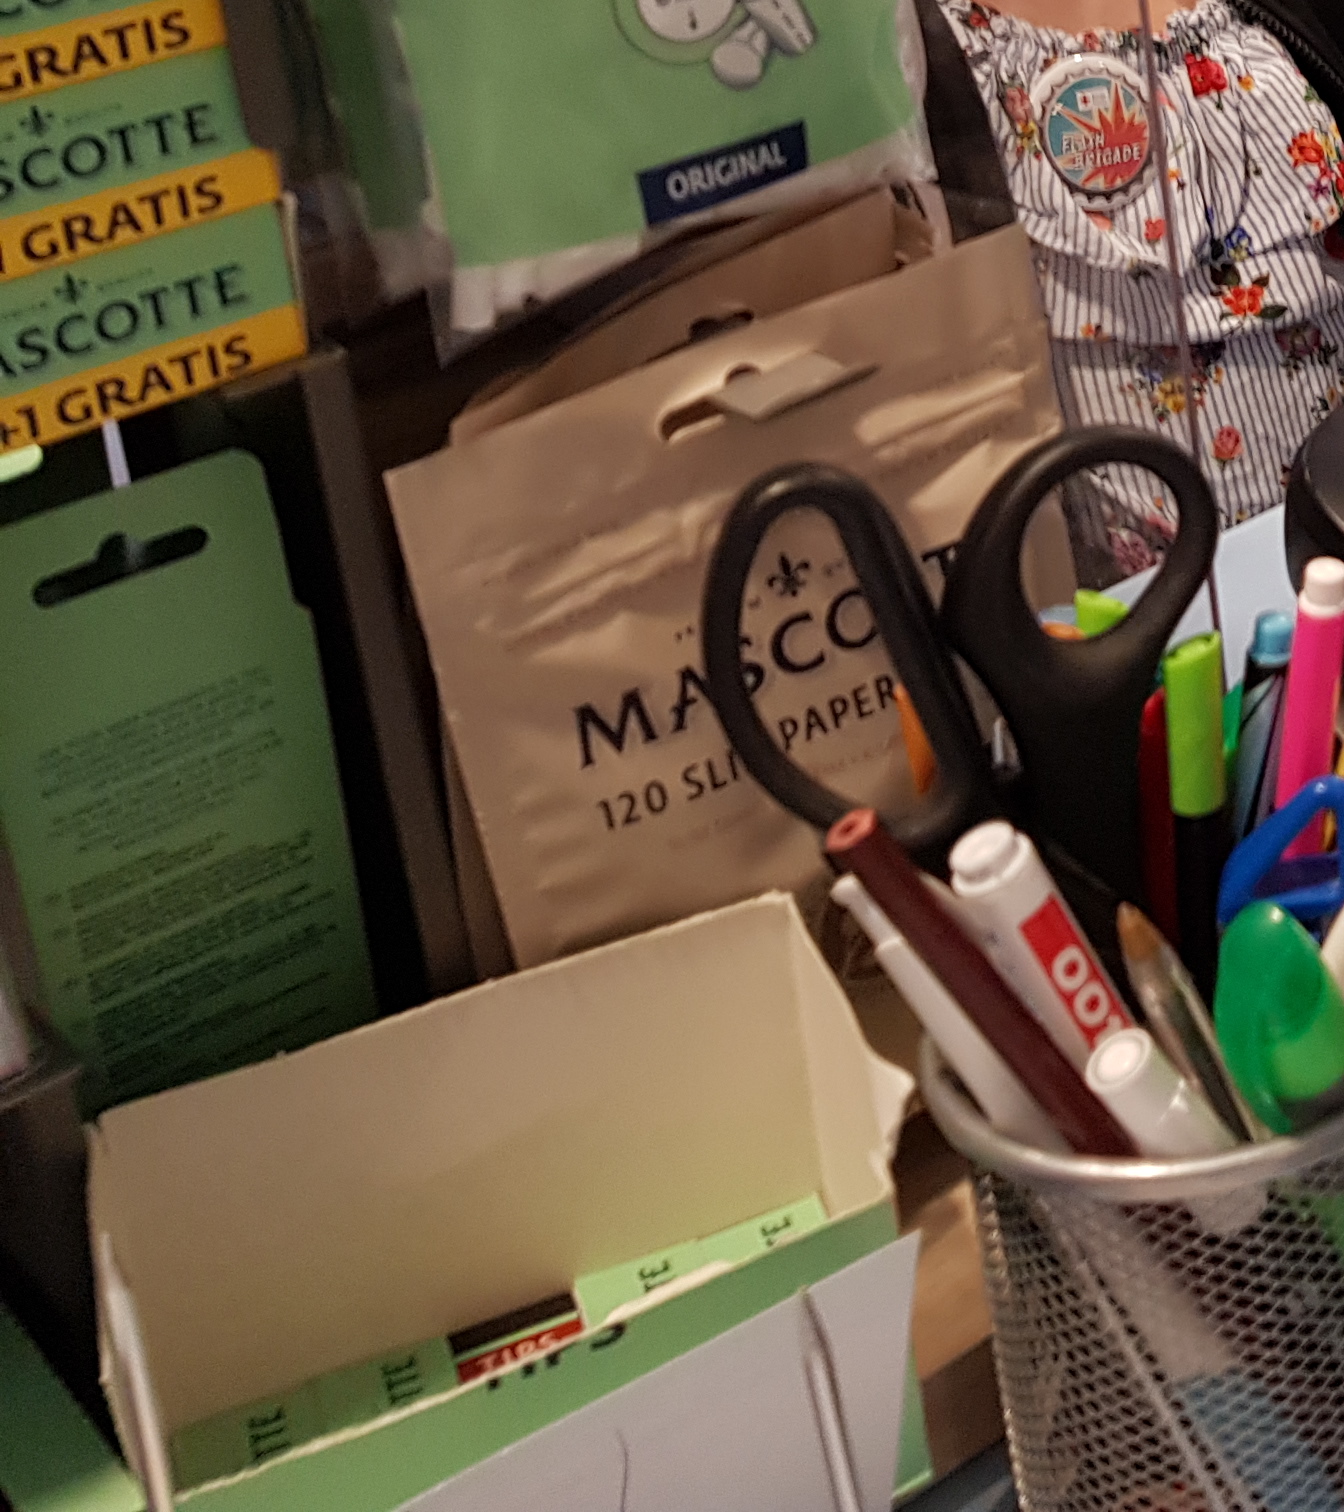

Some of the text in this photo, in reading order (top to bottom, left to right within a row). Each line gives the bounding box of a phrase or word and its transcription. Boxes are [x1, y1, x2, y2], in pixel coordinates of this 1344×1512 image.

[666, 141, 787, 205] ORIGINAL
[1073, 141, 1142, 169] BRIGADE
[21, 174, 225, 264] GRATIS
[56, 334, 255, 429] GRATIS
[596, 779, 668, 832] 120
[681, 749, 742, 802] SLI
